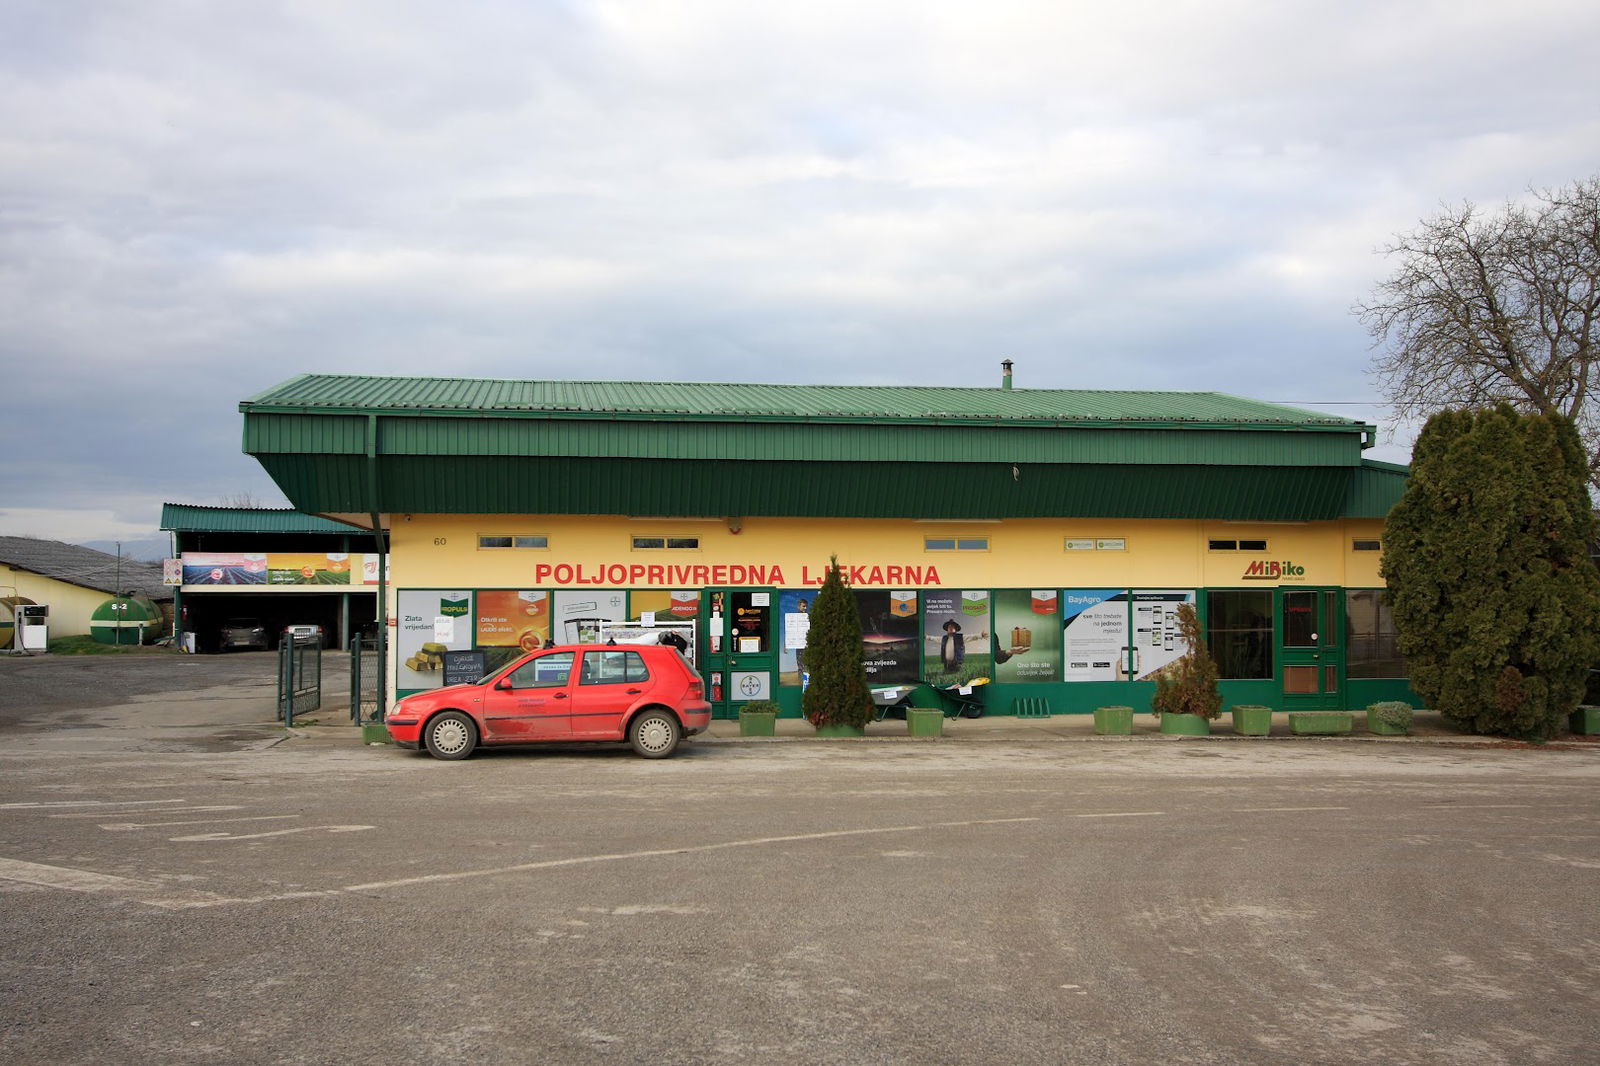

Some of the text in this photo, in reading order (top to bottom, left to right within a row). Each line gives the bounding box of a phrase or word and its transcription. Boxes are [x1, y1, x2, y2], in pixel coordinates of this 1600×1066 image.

[434, 537, 447, 545] 60
[535, 564, 785, 585] POLJOPRIVREDNA
[1242, 560, 1305, 580] MiBiko
[1068, 595, 1101, 605] BayAgro
[1100, 620, 1122, 628] jednom
[874, 659, 897, 668] zvijezda
